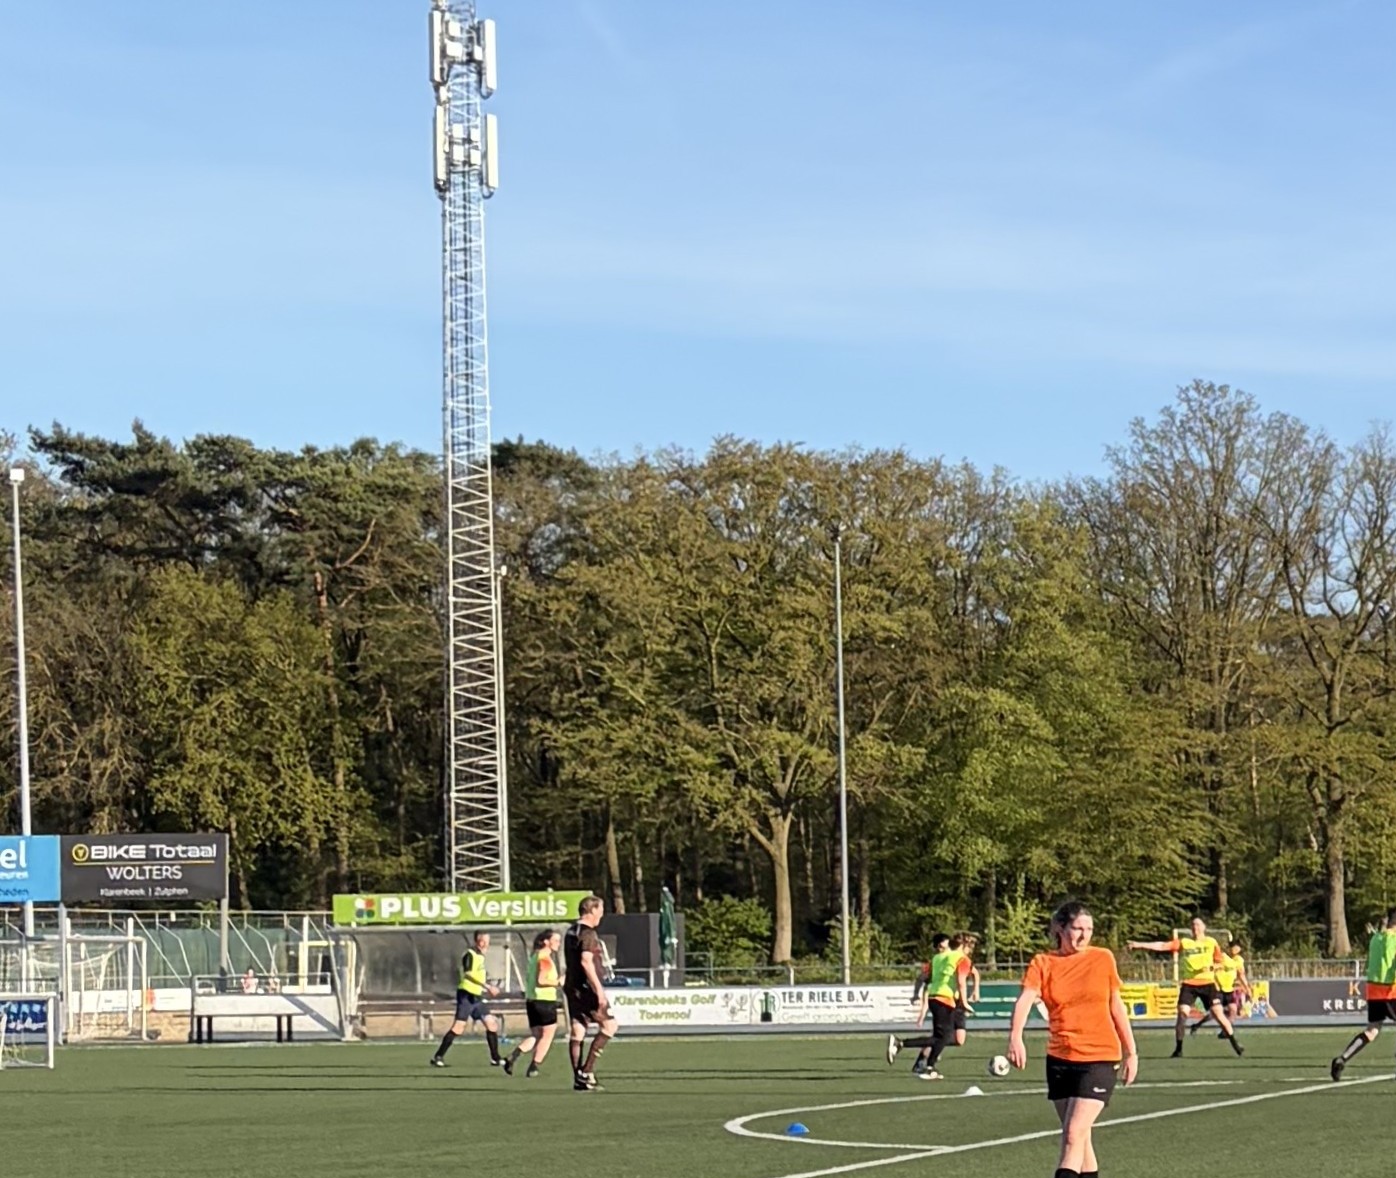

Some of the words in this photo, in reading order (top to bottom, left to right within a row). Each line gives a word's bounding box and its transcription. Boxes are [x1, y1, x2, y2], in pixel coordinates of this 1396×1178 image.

[90, 844, 146, 859] BIKE
[150, 844, 217, 858] Totaal
[105, 865, 183, 880] WOLTERS
[380, 897, 461, 918] PLUS
[467, 896, 568, 916] Versluis
[690, 993, 717, 1006] Golf
[782, 991, 804, 1004] TER
[808, 990, 843, 1003] RIELE
[1322, 999, 1368, 1011] KREP
